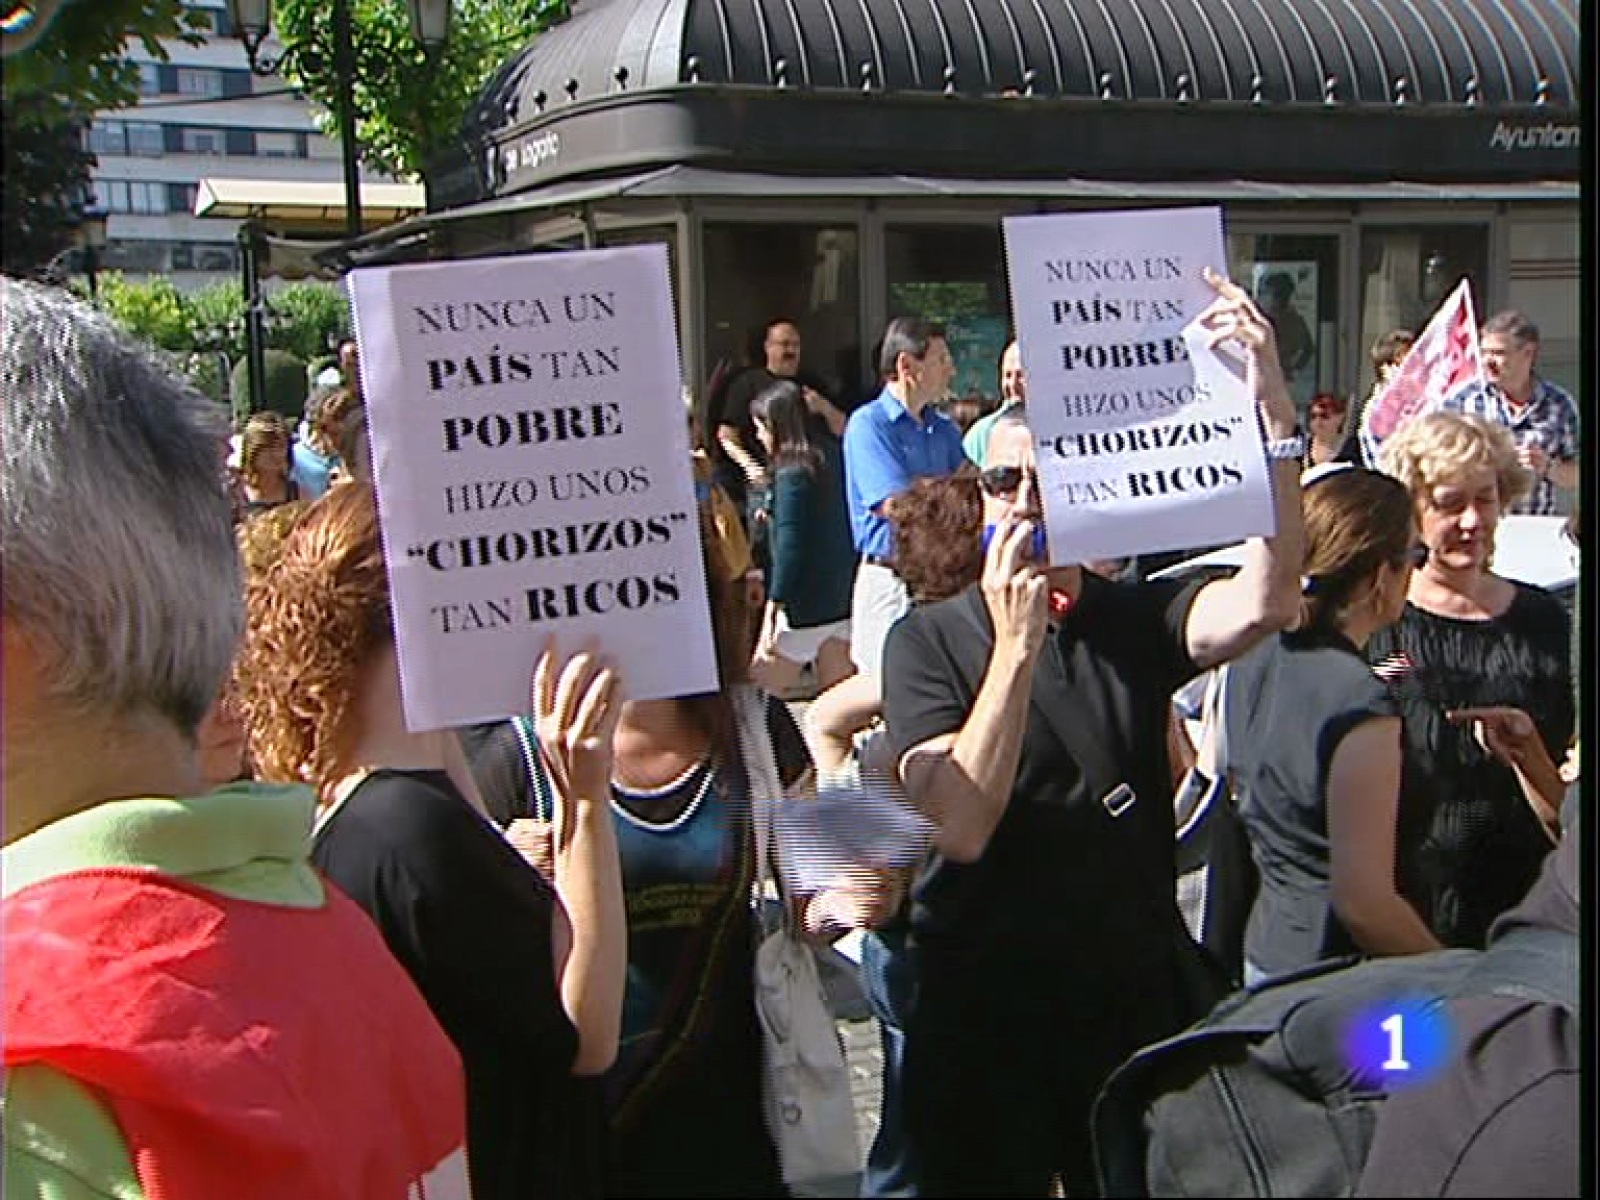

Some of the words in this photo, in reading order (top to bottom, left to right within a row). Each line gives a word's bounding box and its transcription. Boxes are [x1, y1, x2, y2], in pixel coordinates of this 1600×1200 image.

[1045, 259, 1136, 284] NUNCA
[1145, 256, 1182, 280] UN
[414, 298, 551, 334] NUNCA
[563, 291, 616, 322] UN
[1051, 292, 1122, 325] PAÍS
[1129, 300, 1184, 323] TAN
[427, 345, 532, 391] PAÍS
[541, 347, 620, 379] TAN
[1061, 336, 1190, 371] POBRE
[1063, 391, 1130, 418] HIZO
[1135, 382, 1212, 411] UNOS
[443, 402, 623, 452] POBRE
[444, 475, 538, 514] HIZO
[549, 466, 651, 503] UNOS
[1060, 478, 1119, 506] TAN
[1127, 462, 1244, 498] RICOS
[431, 599, 513, 635] TAN
[523, 573, 681, 622] RICOS
